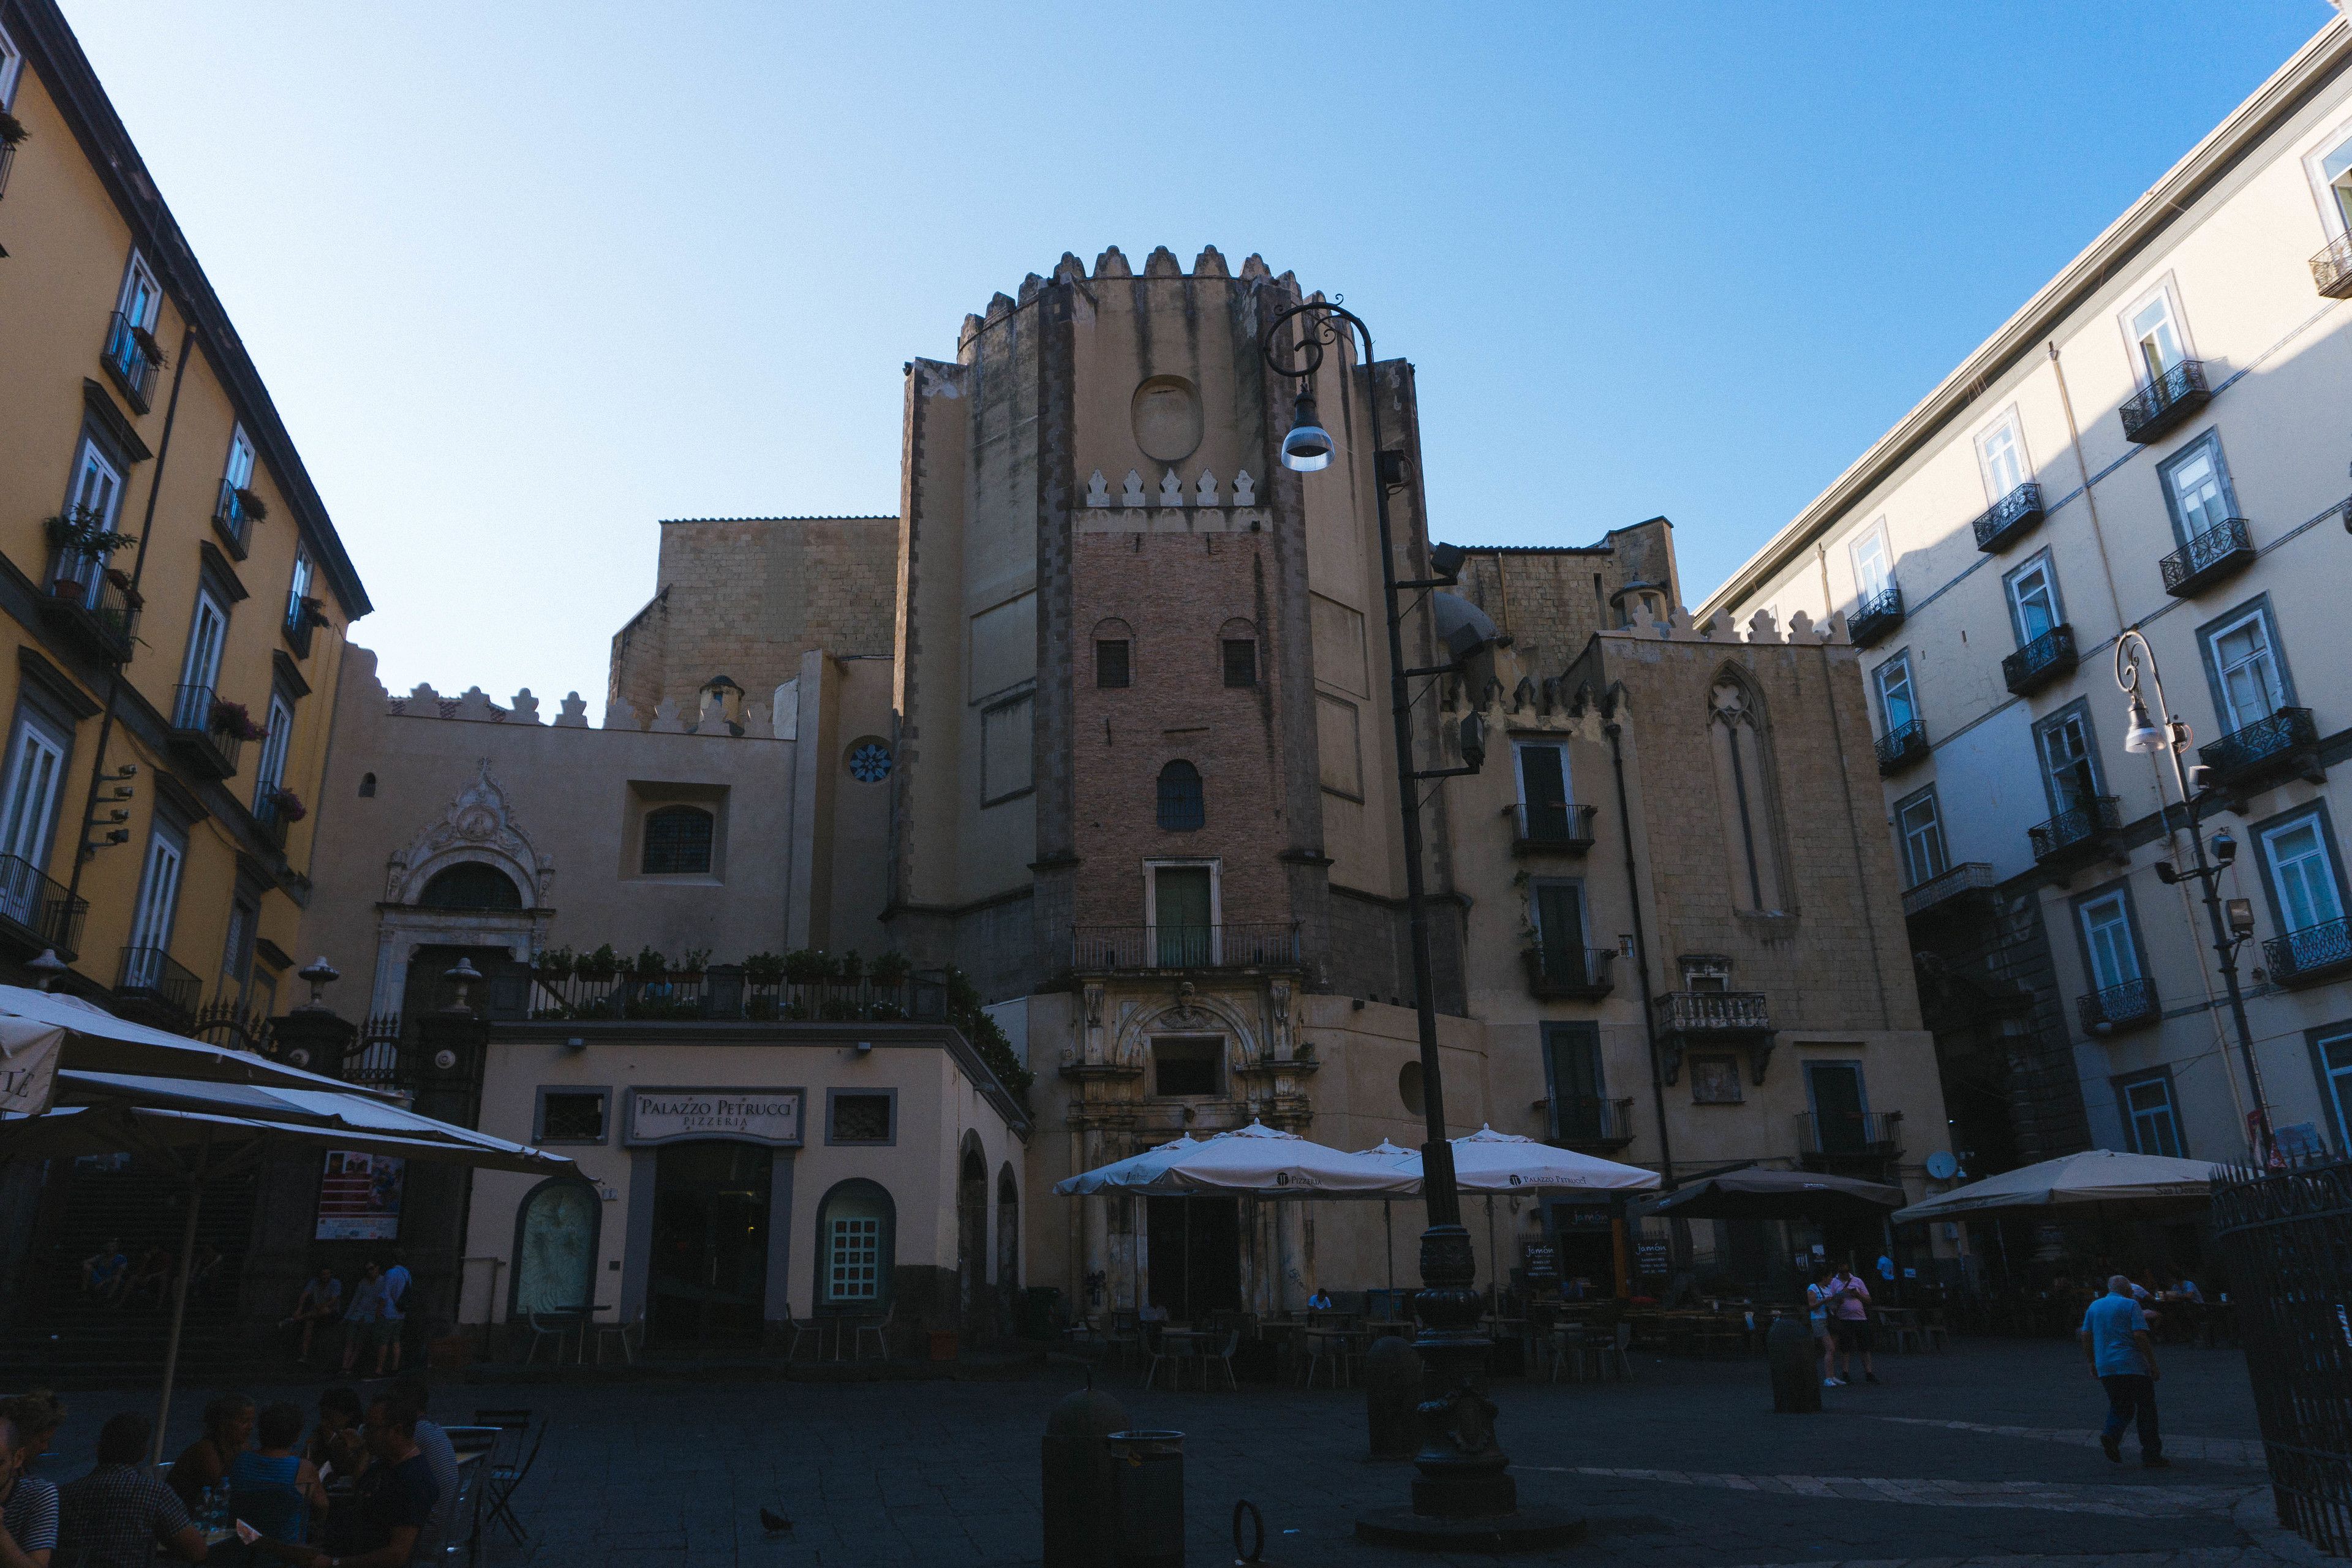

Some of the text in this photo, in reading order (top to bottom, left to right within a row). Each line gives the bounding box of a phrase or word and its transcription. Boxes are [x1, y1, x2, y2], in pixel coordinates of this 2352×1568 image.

[641, 1099, 791, 1115] PALAZZO PETRUCCI
[683, 1117, 748, 1126] PIZZERIA
[1291, 1176, 1322, 1185] PIZZERIA
[1526, 1245, 1555, 1257] jamón
[1635, 1242, 1667, 1256] jamón
